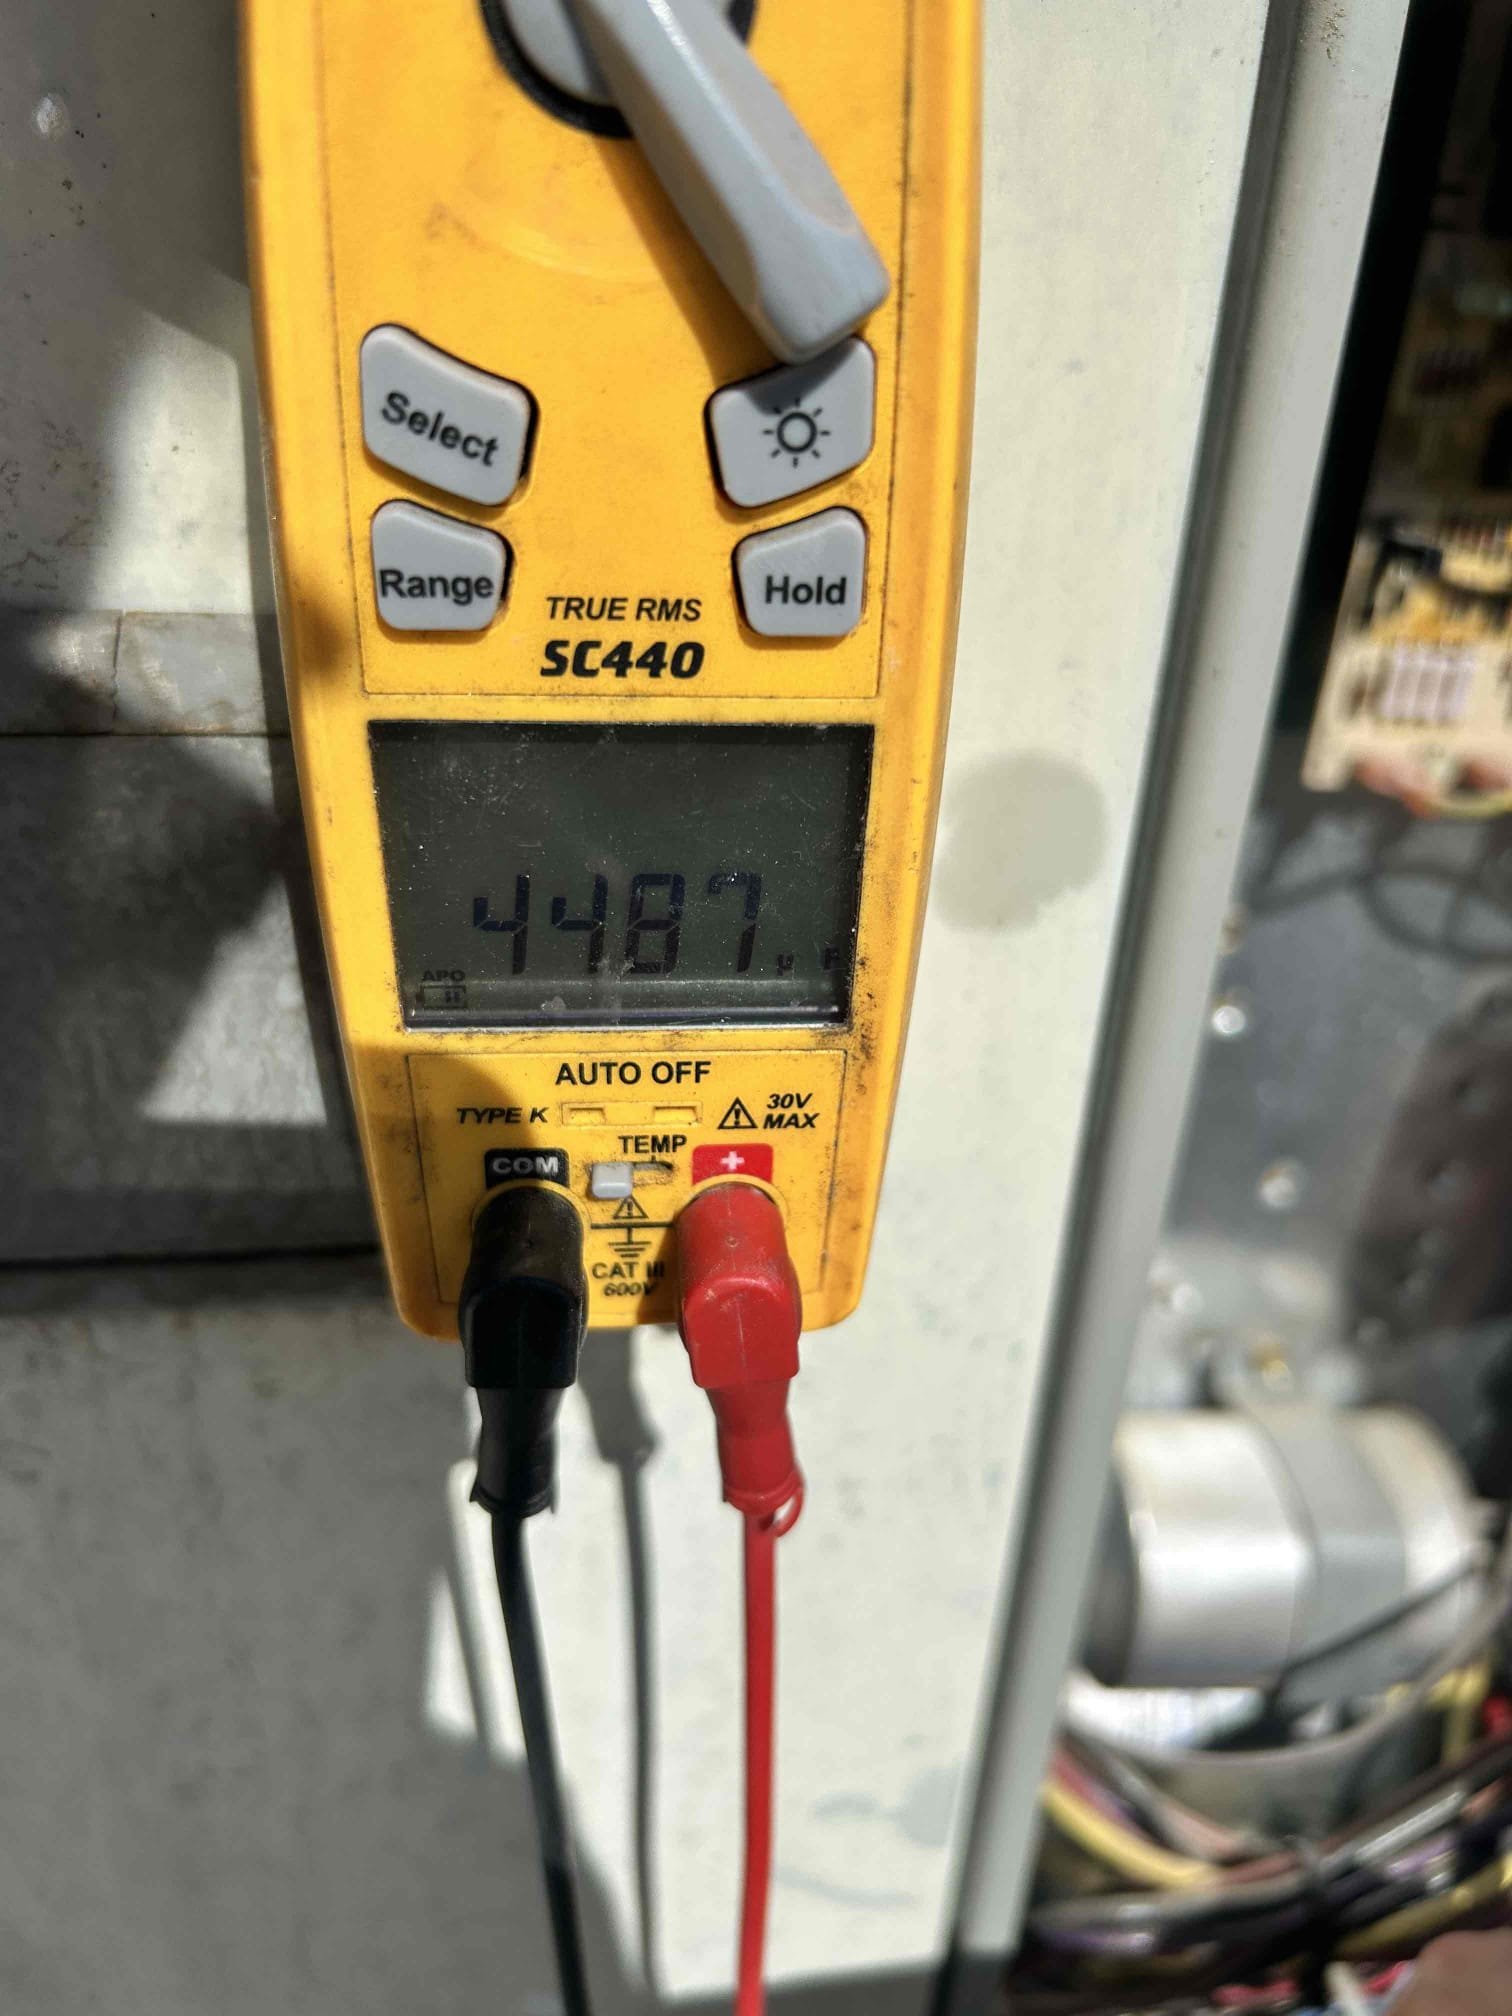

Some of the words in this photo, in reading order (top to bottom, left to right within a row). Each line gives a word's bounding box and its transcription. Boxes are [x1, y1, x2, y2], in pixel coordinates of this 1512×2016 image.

[380, 391, 500, 468] Select
[378, 568, 495, 606] Range
[763, 575, 847, 605] Hold
[545, 596, 626, 621] TRUE
[634, 597, 702, 622] RMS
[539, 640, 705, 679] SC440
[422, 968, 466, 983] APO
[555, 1062, 641, 1086] AUTO
[651, 1061, 711, 1084] OFF
[766, 1093, 814, 1110] 30V
[456, 1107, 523, 1124] TYPE
[528, 1107, 550, 1123] K
[763, 1112, 819, 1130] MAX
[618, 1135, 687, 1154] TEMP
[491, 1155, 560, 1174] COM
[591, 1261, 639, 1280] CAT
[602, 1281, 658, 1297] 600V
